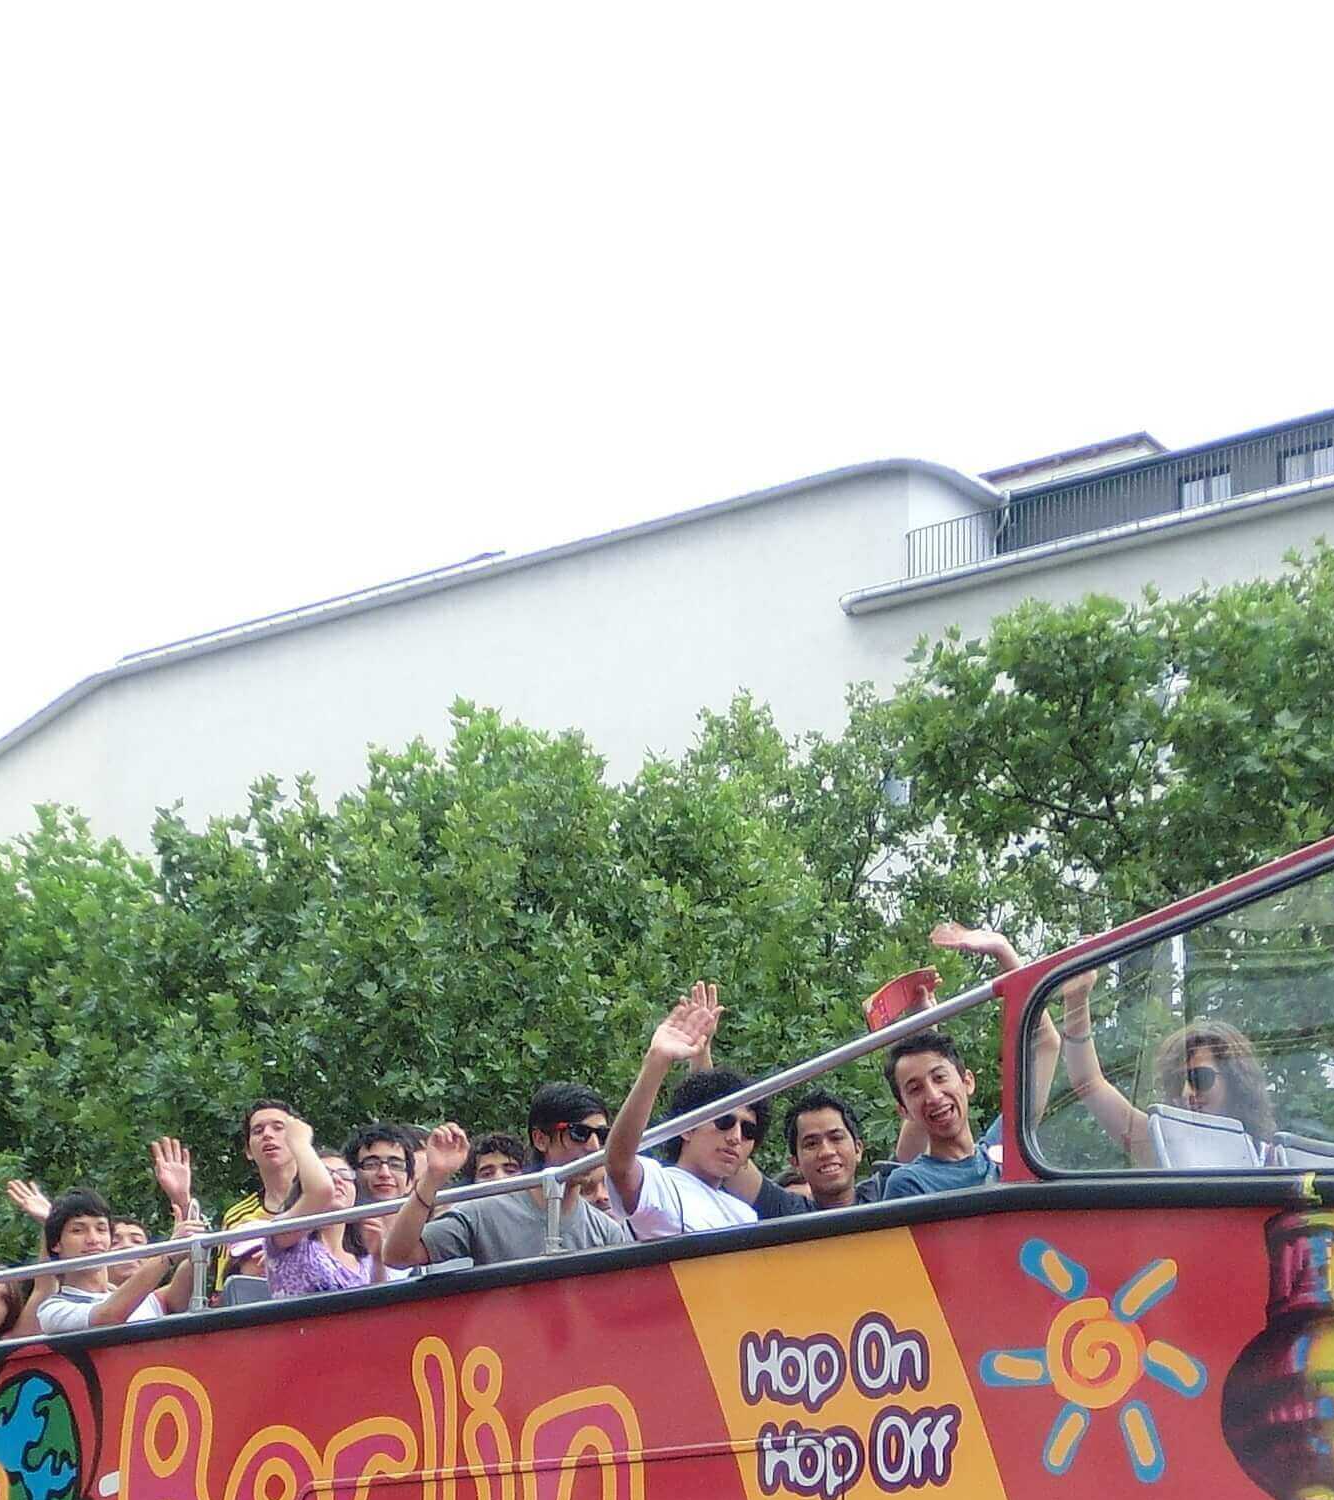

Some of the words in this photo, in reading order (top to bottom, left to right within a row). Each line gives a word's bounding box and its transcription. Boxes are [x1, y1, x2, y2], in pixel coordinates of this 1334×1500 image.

[742, 1331, 844, 1411] Hop
[851, 1313, 929, 1390] On
[870, 1405, 960, 1494] Off
